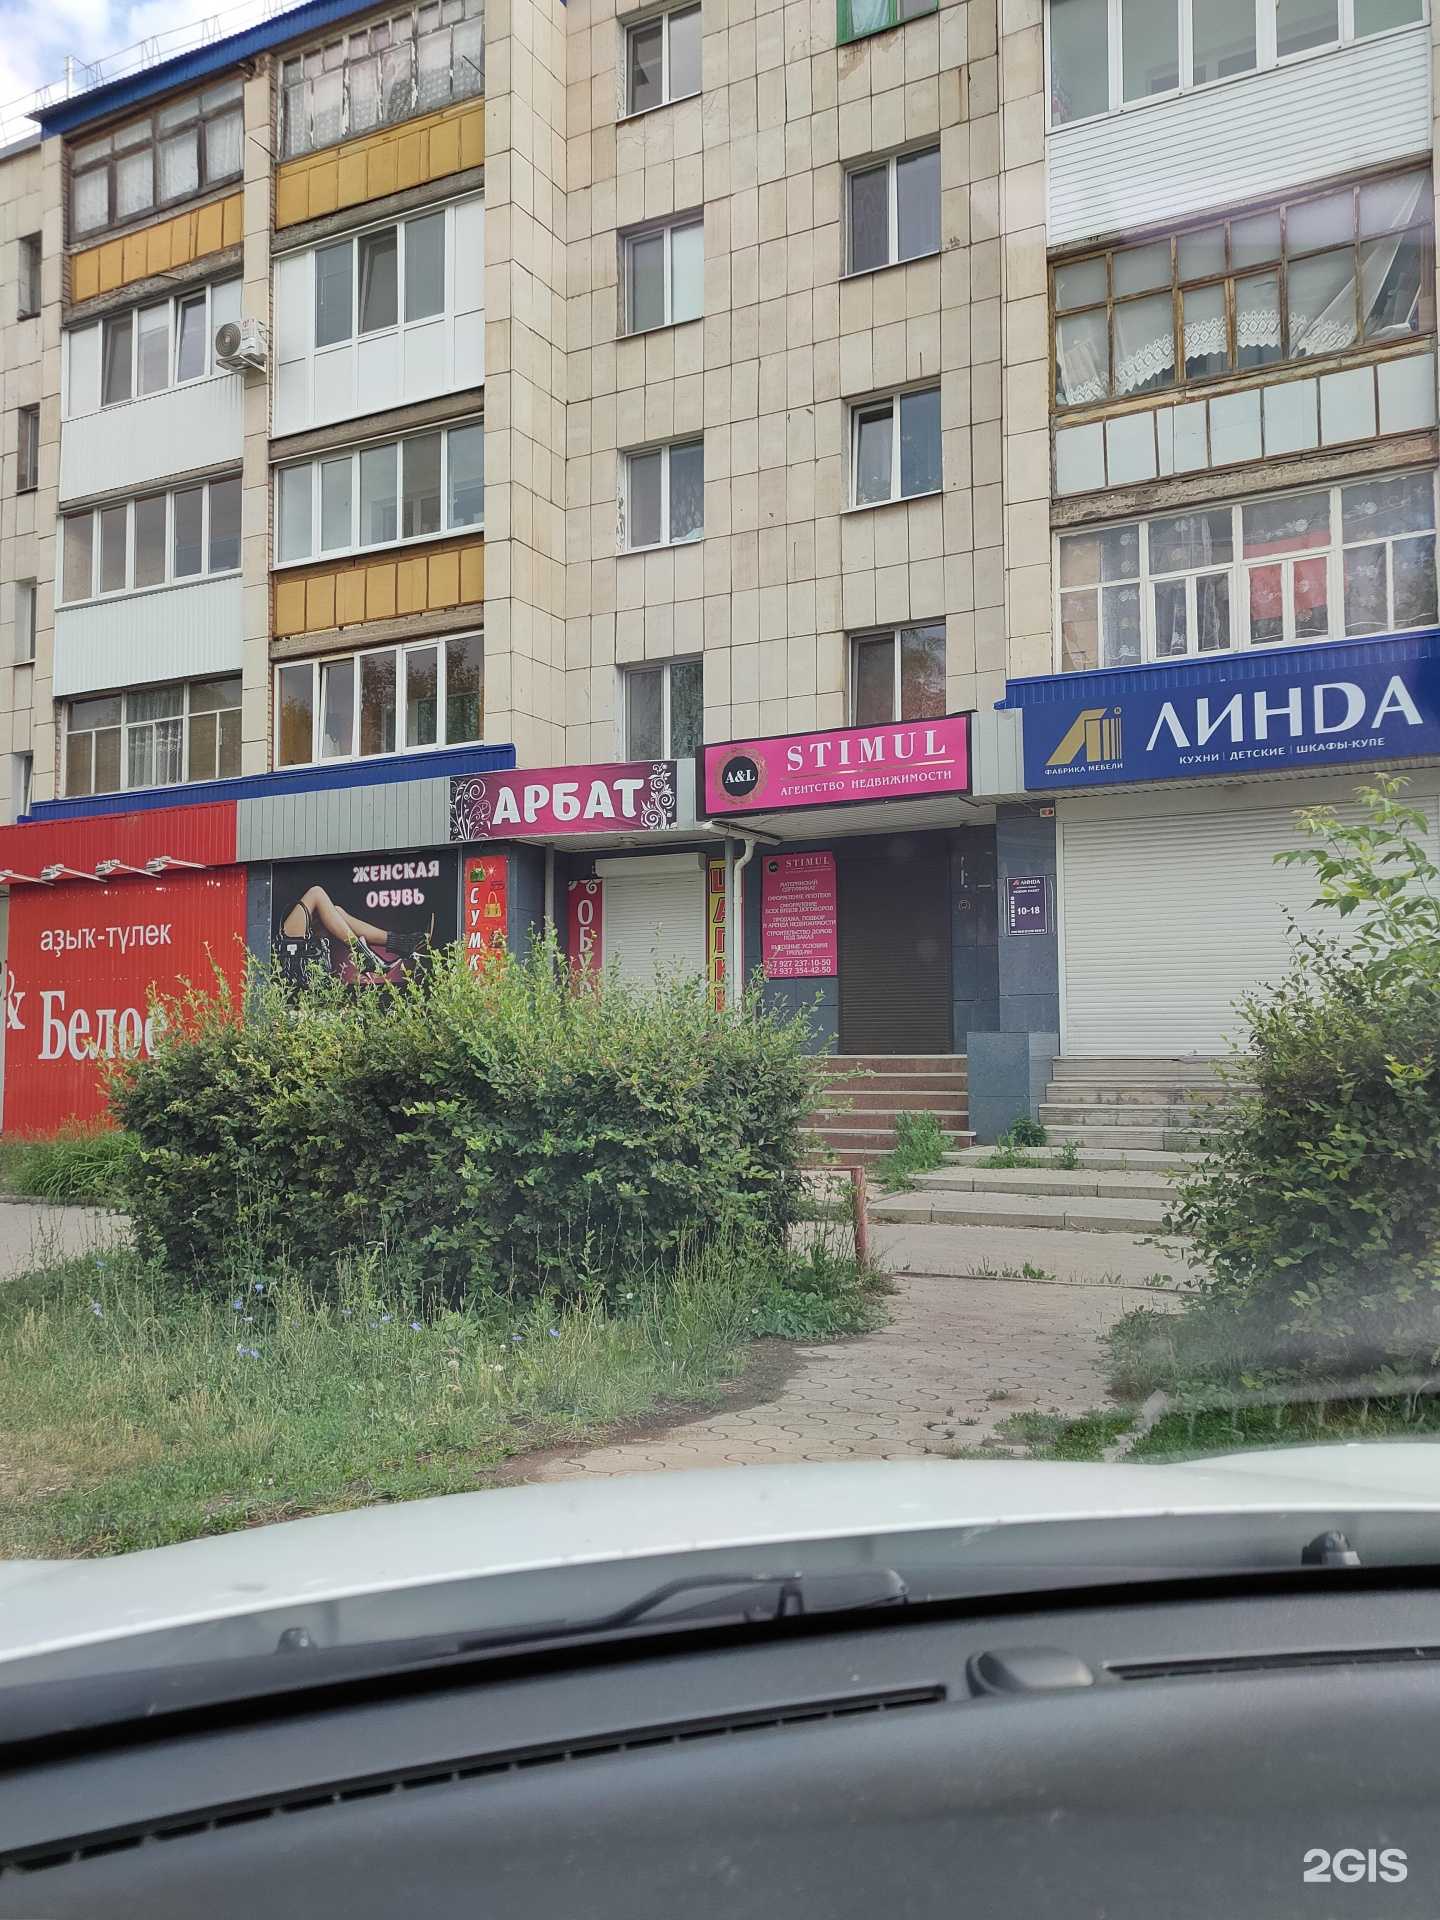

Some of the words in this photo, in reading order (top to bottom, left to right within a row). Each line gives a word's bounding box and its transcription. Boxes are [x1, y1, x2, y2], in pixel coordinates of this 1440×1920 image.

[786, 729, 946, 772] STIMUL
[1179, 752, 1220, 765] КУХНИ
[1230, 746, 1287, 761] ДЕТСКИЕ
[1296, 736, 1386, 755] ШКАФЫ-КУПЕ
[724, 769, 756, 785] A&L
[1044, 766, 1086, 776] ФАБРИКА
[1088, 762, 1124, 772] МЕБЕЛИ
[780, 781, 845, 797] АГЕНТСТВО
[851, 769, 952, 790] НЕДВИЖИМОСТИ
[491, 778, 645, 826] АРБАТ
[352, 860, 440, 884] ЖЕНСКАЯ
[785, 856, 830, 868] STIMUL
[366, 888, 425, 909] ОБУВЬ
[1017, 906, 1041, 915] 10-18
[467, 887, 482, 973] СУМК
